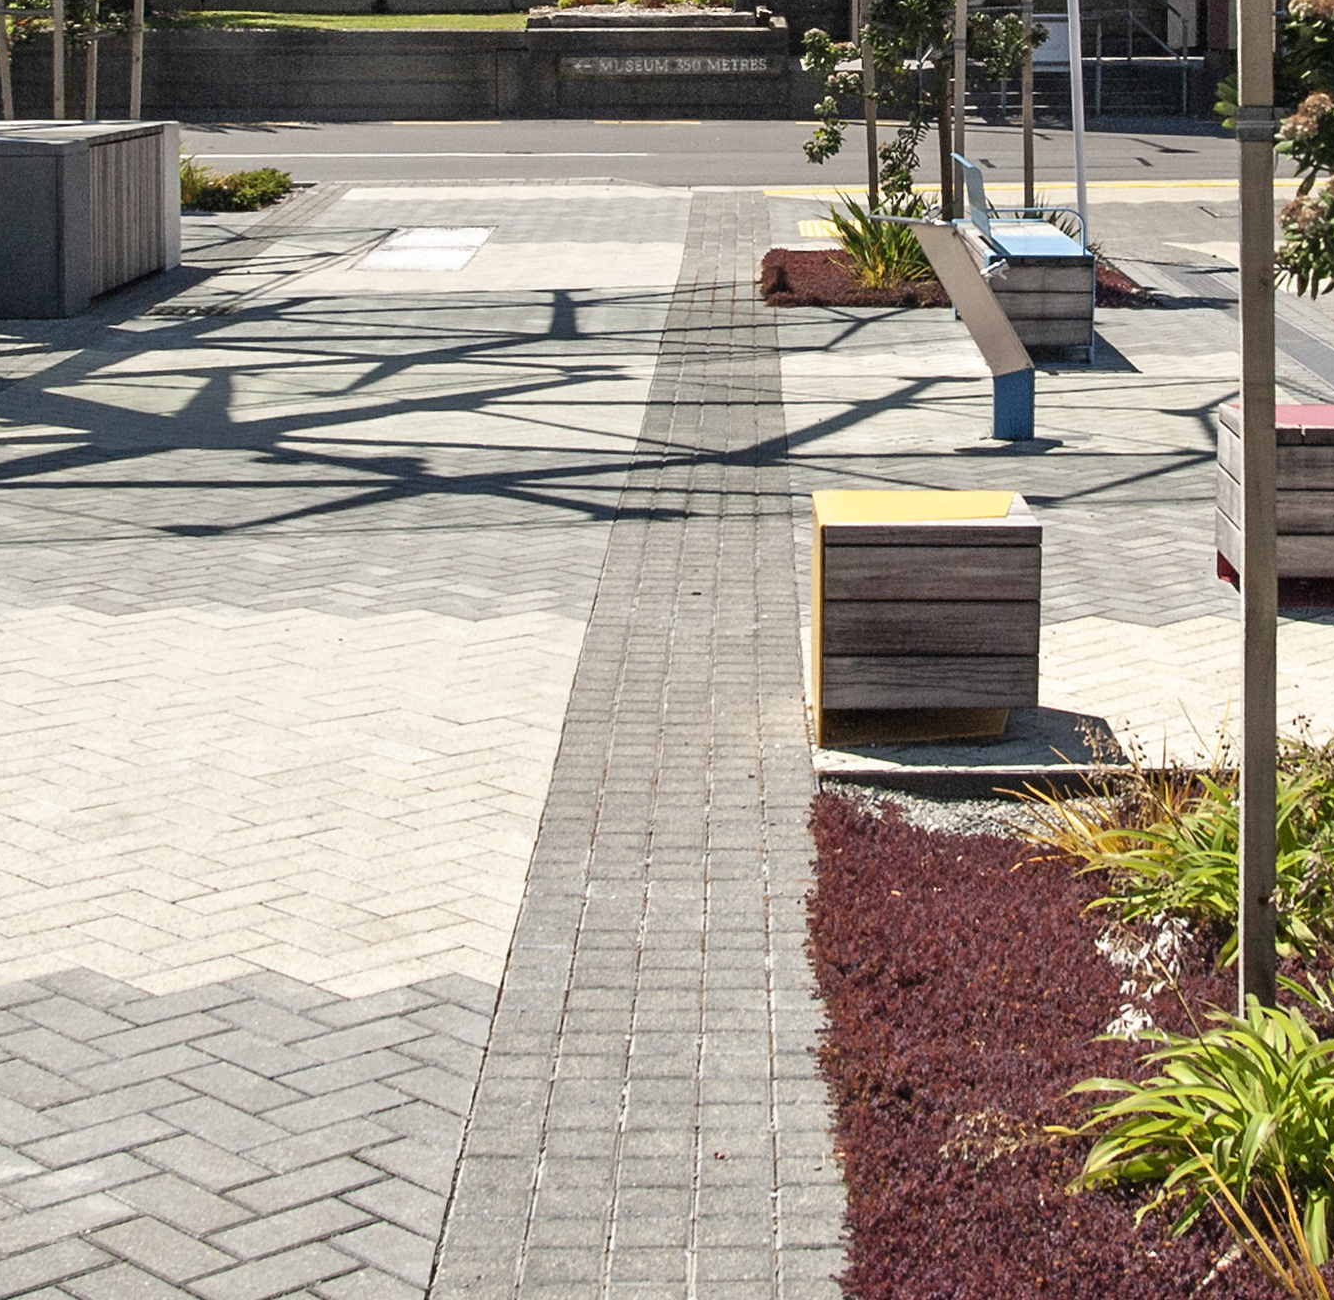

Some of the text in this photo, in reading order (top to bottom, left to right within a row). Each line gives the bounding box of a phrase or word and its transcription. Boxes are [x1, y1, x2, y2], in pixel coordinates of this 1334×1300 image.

[599, 58, 768, 73] MUSEUM 350 METRES
